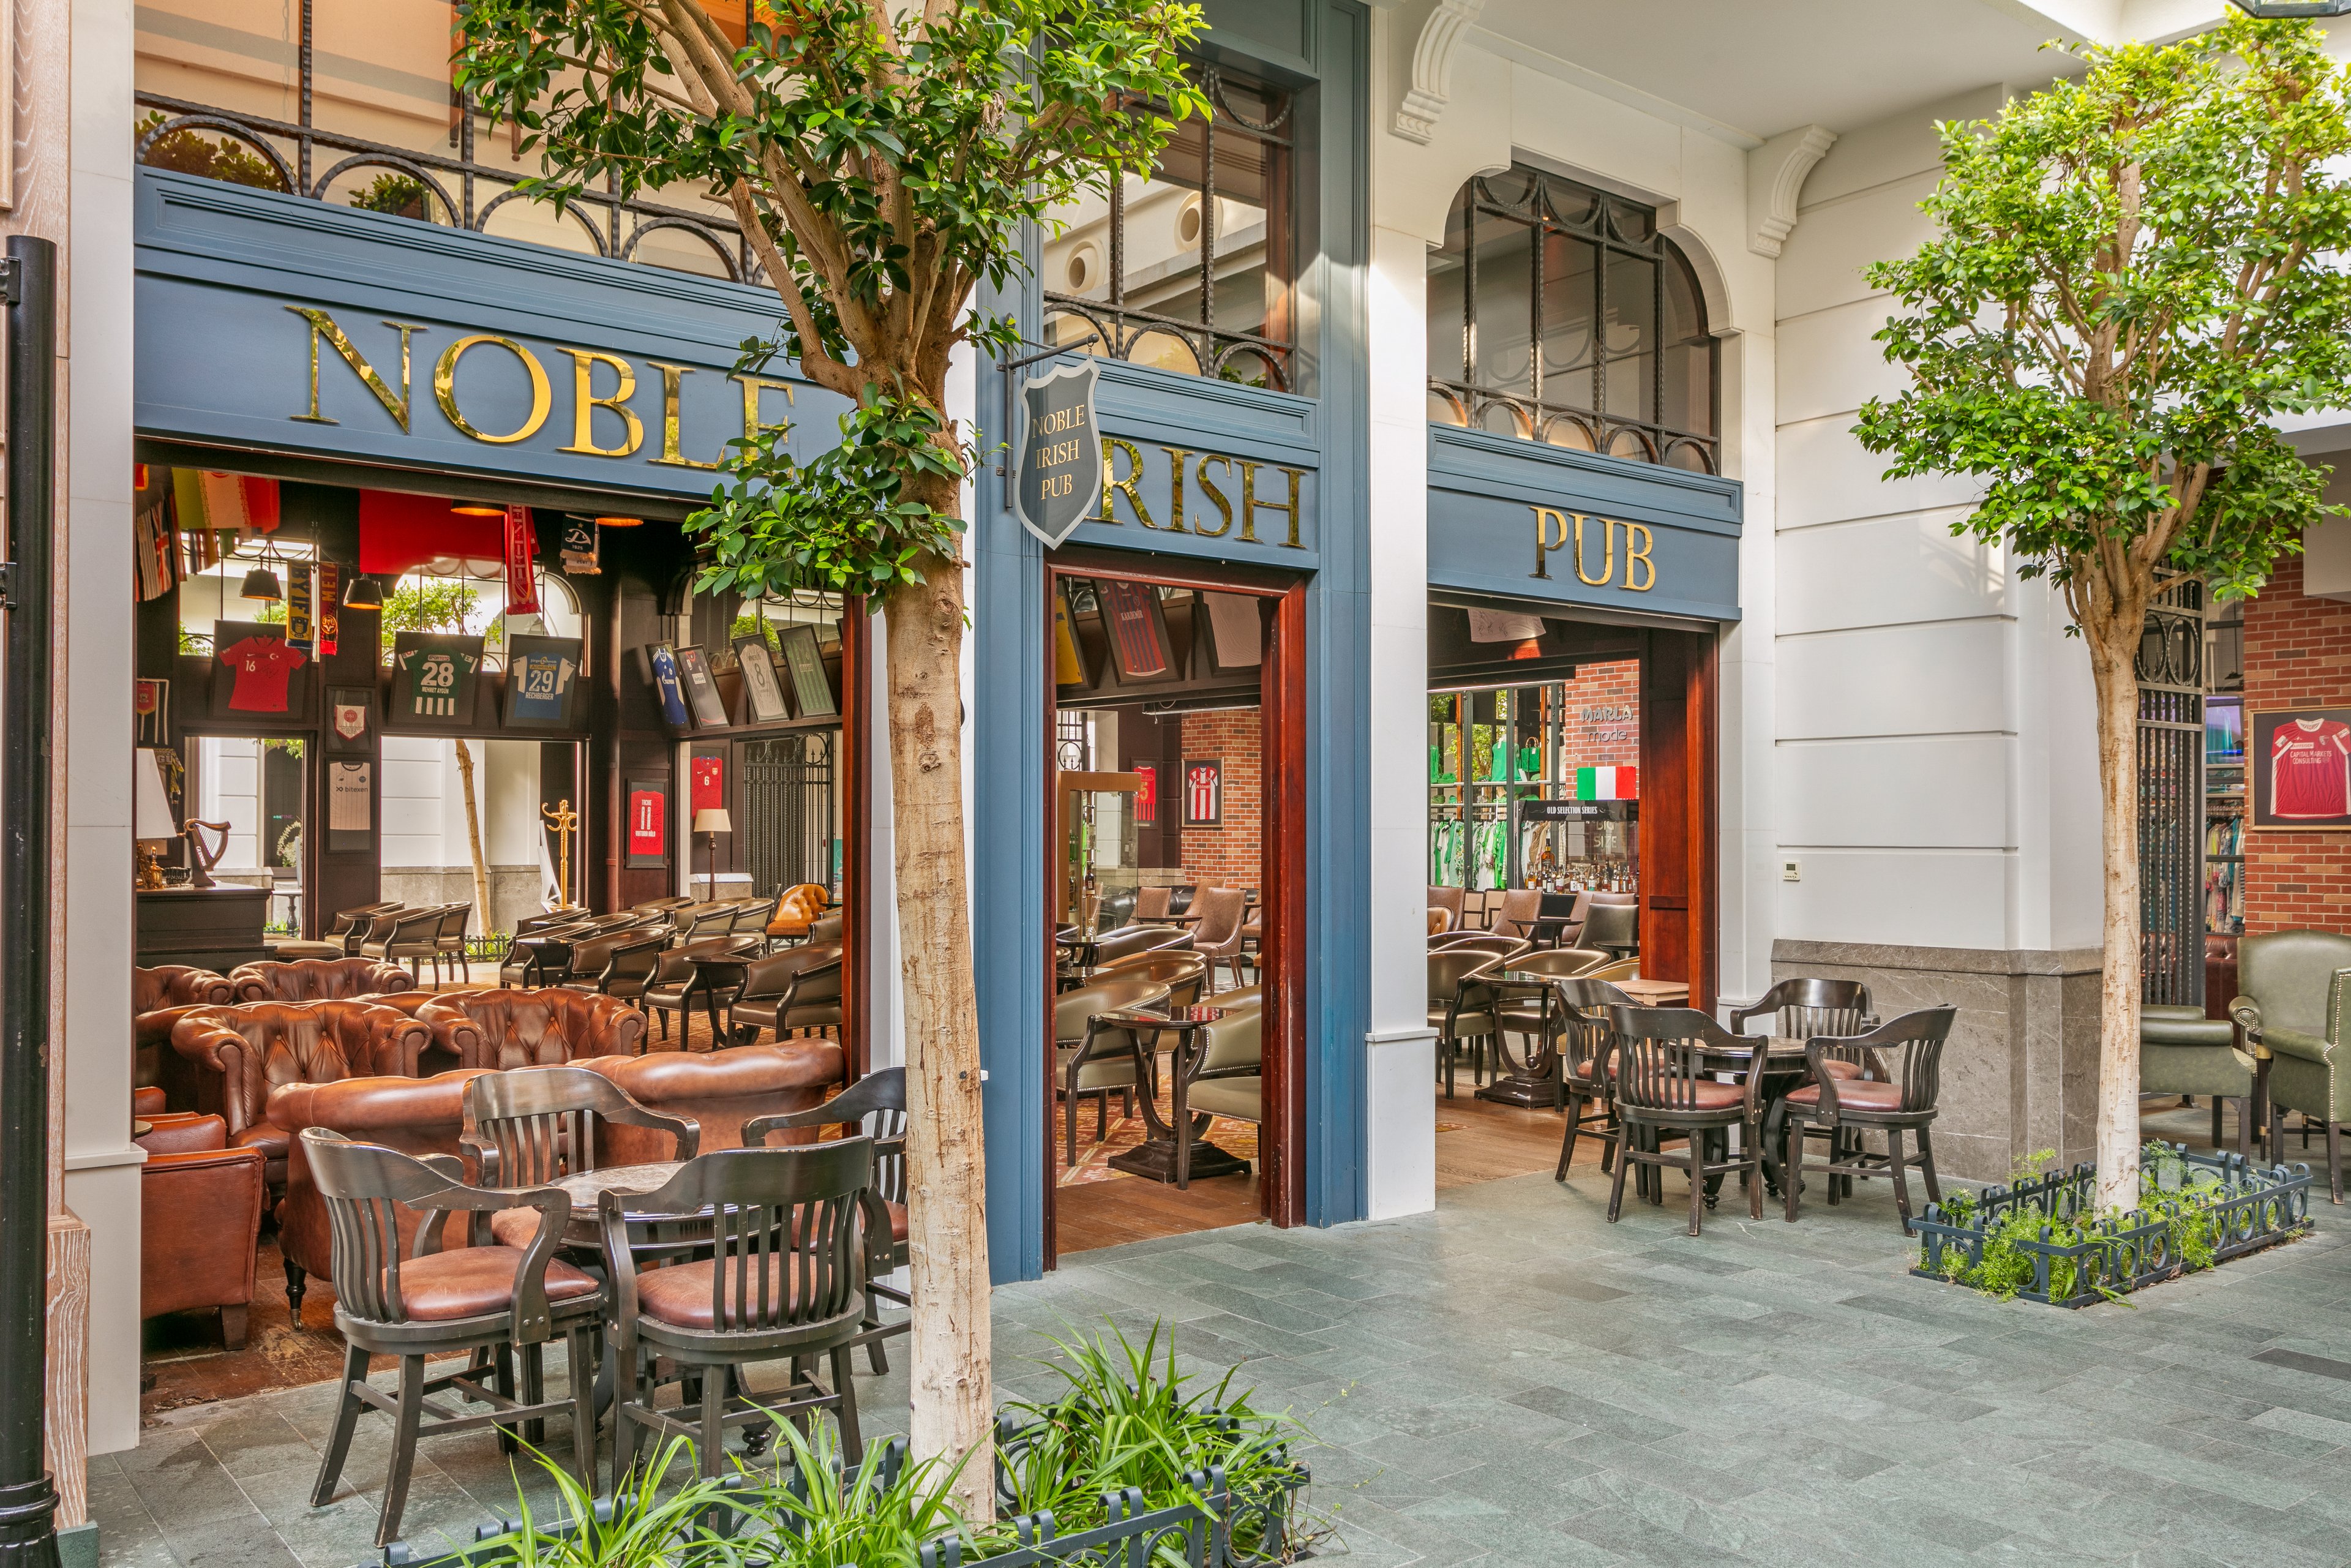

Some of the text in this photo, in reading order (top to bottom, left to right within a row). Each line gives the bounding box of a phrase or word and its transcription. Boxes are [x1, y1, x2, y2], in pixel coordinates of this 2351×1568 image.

[284, 304, 794, 480] NOBLE
[1032, 404, 1085, 439] NOBLE
[1036, 438, 1080, 470] IRISH
[1041, 474, 1073, 500] PUB
[1084, 437, 1307, 549] RISH
[1528, 506, 1656, 591] PUB
[1120, 609, 1144, 621] KARDEMİR
[246, 660, 256, 672] 16
[421, 662, 454, 687] 28
[754, 662, 765, 688] 8
[529, 670, 553, 692] 29
[525, 691, 554, 700] RECHBERGER
[1581, 705, 1633, 722] MARLA
[1588, 729, 1628, 742] mode
[704, 776, 710, 786] 6
[1139, 781, 1148, 801] 5
[640, 806, 651, 830] 11
[1557, 806, 1581, 815] SELECTION
[1581, 806, 1598, 815] SERIES
[1594, 835, 1617, 848] SIZE
[196, 846, 207, 867] GUINNESS
